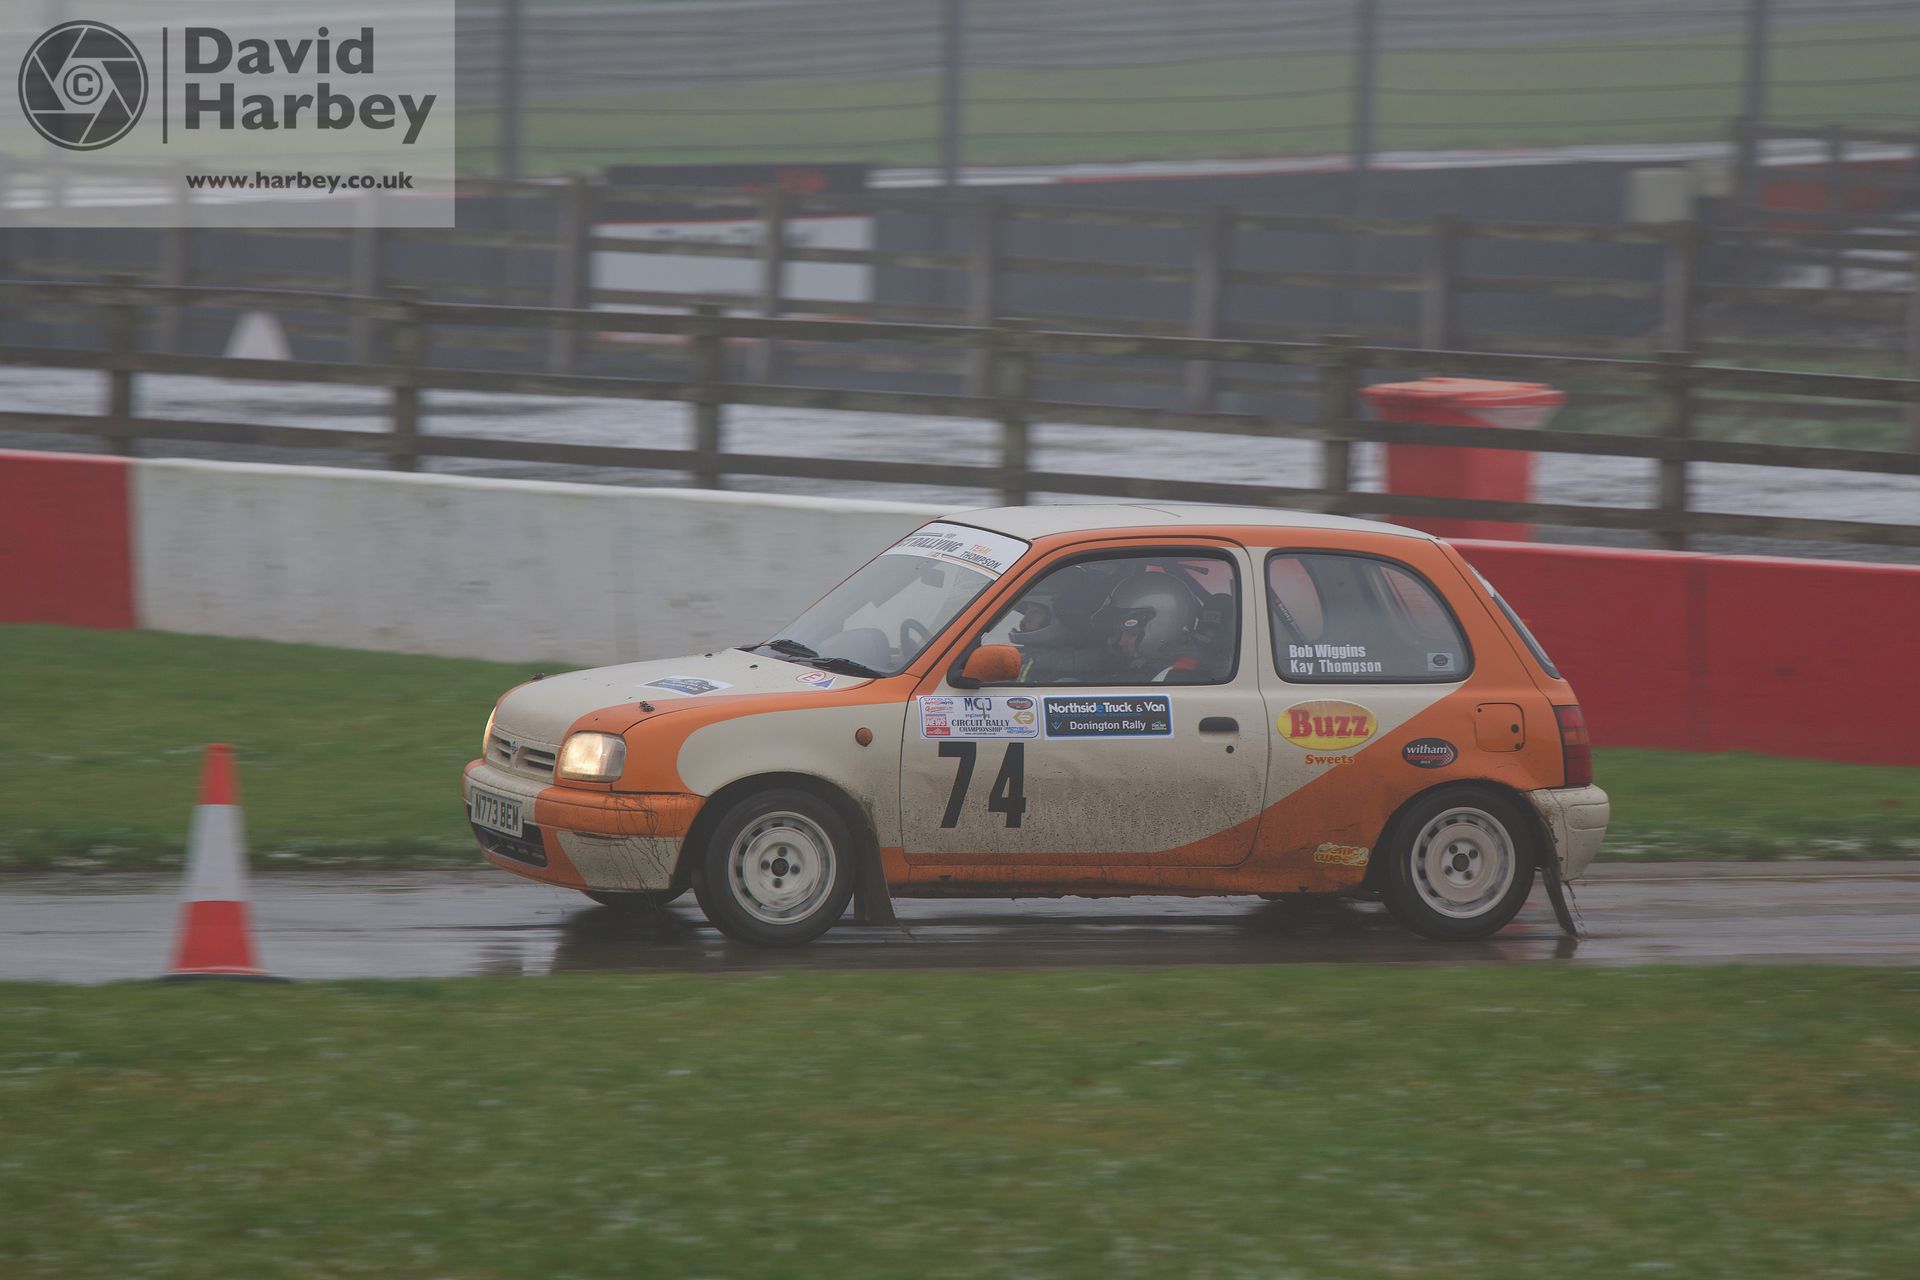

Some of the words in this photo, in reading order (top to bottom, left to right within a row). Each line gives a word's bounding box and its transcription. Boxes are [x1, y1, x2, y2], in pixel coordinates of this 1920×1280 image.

[960, 551, 1002, 569] THOMPSON
[1289, 644, 1313, 658] Bob
[1315, 644, 1366, 659] Wiggins
[1290, 660, 1314, 675] Kay
[1319, 660, 1382, 675] Thompson
[1048, 702, 1103, 714] Northside
[1103, 701, 1133, 713] Truck
[1135, 704, 1143, 713] &
[1144, 701, 1166, 712] Van
[951, 719, 983, 727] CIRCUIT
[986, 719, 1010, 727] RALLY
[1069, 720, 1120, 732] Donington
[1122, 720, 1146, 731] Rally
[1287, 709, 1369, 738] Buzz
[1406, 744, 1447, 754] witham
[1305, 754, 1355, 765] Sweets
[939, 742, 1026, 828] 74
[474, 793, 499, 825] N773
